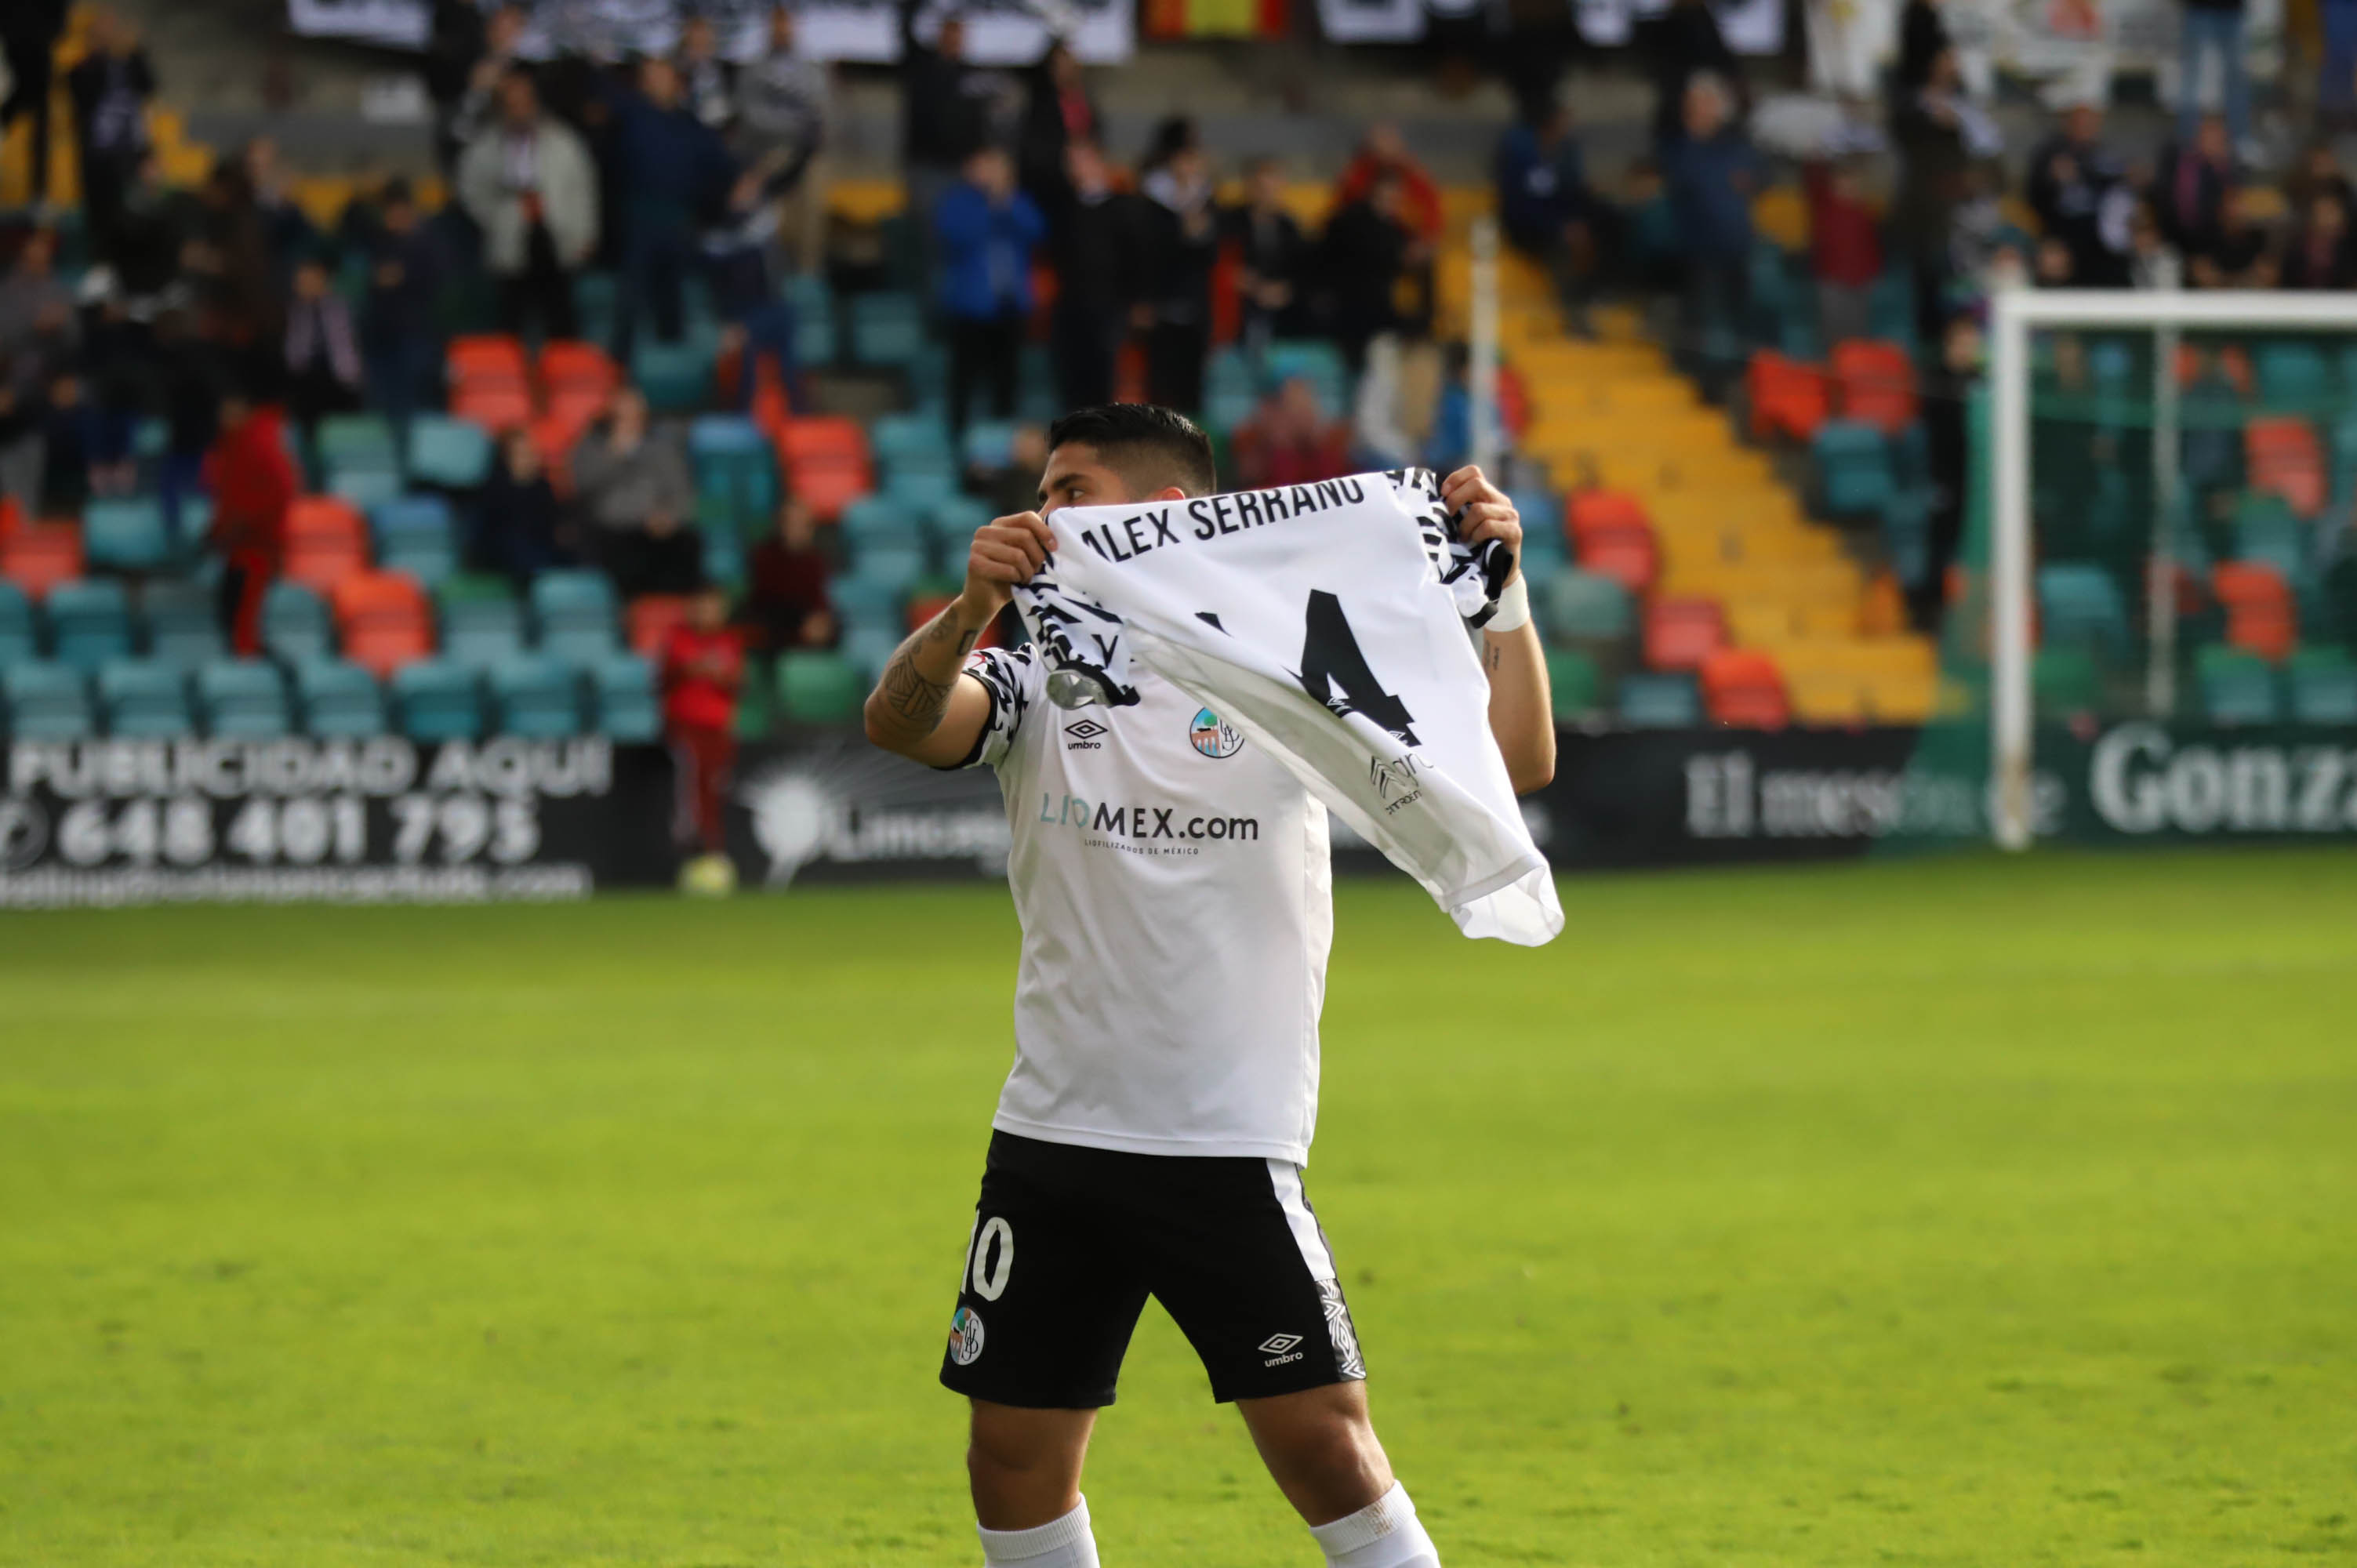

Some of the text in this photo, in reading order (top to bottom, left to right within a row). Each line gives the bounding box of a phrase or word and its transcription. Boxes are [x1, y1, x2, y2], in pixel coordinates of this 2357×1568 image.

[1081, 508, 1180, 563] ALEX
[8, 734, 418, 798] PUBLICIDAD
[1067, 741, 1102, 750] umbro
[1040, 792, 1258, 840] LIOMEX.com
[1684, 750, 1755, 838] El
[58, 792, 541, 865] 648 401 795
[1084, 838, 1143, 855] LIOFILIZADOS
[1265, 1352, 1303, 1367] umbro
